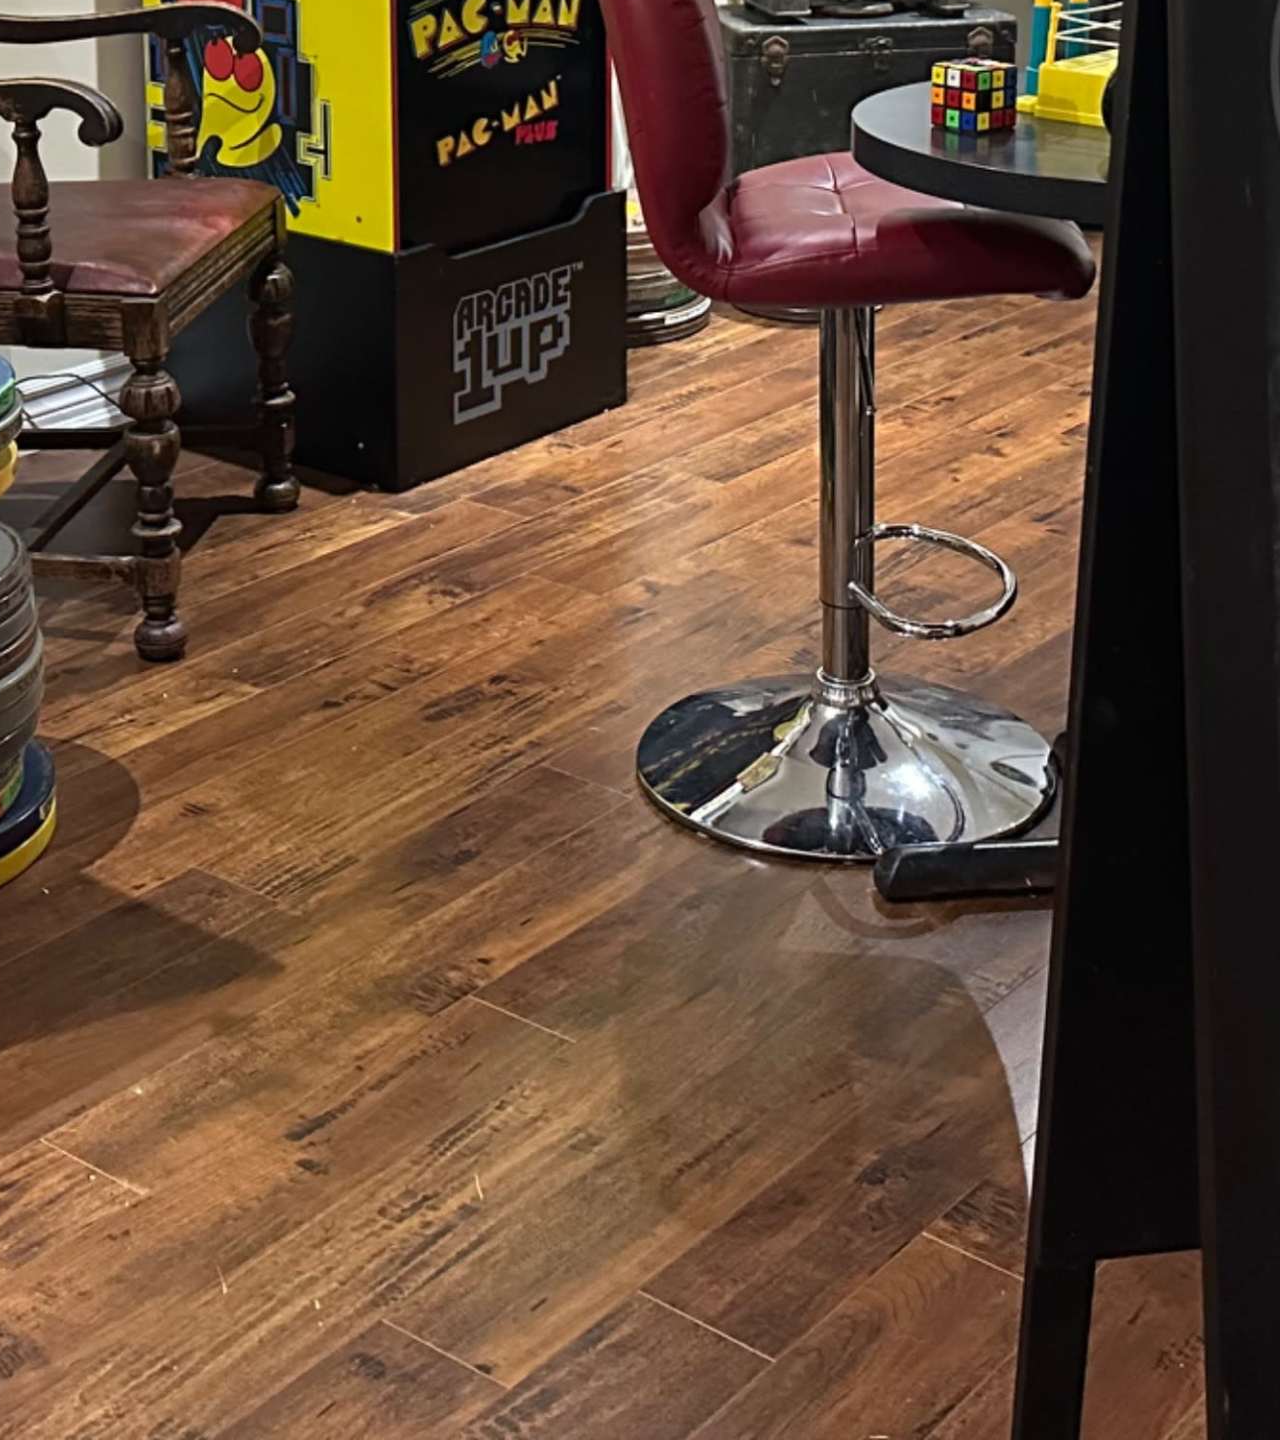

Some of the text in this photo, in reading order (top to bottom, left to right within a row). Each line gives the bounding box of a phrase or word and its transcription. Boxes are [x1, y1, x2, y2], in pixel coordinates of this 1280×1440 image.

[436, 79, 559, 167] PAC-MAN
[455, 266, 570, 341] ARCADE
[455, 314, 569, 423] 1UP
